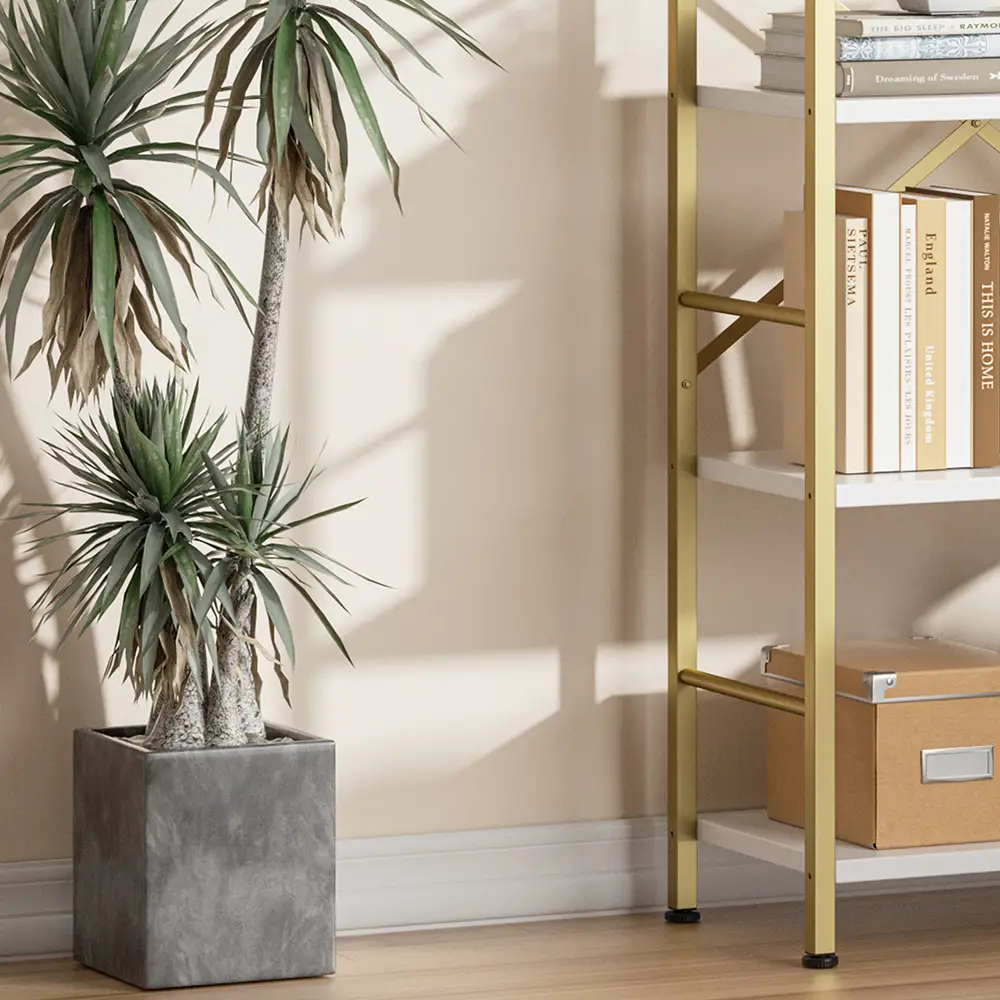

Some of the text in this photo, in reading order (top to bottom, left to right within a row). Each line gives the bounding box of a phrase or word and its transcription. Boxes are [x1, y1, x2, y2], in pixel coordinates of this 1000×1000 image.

[875, 72, 979, 84] Dreaming of Sweden
[847, 228, 856, 306] SIETSEMA
[859, 229, 867, 269] PAUL
[921, 233, 937, 296] England
[981, 281, 994, 390] THIS IS HOME
[922, 345, 935, 444] United Kingdom
